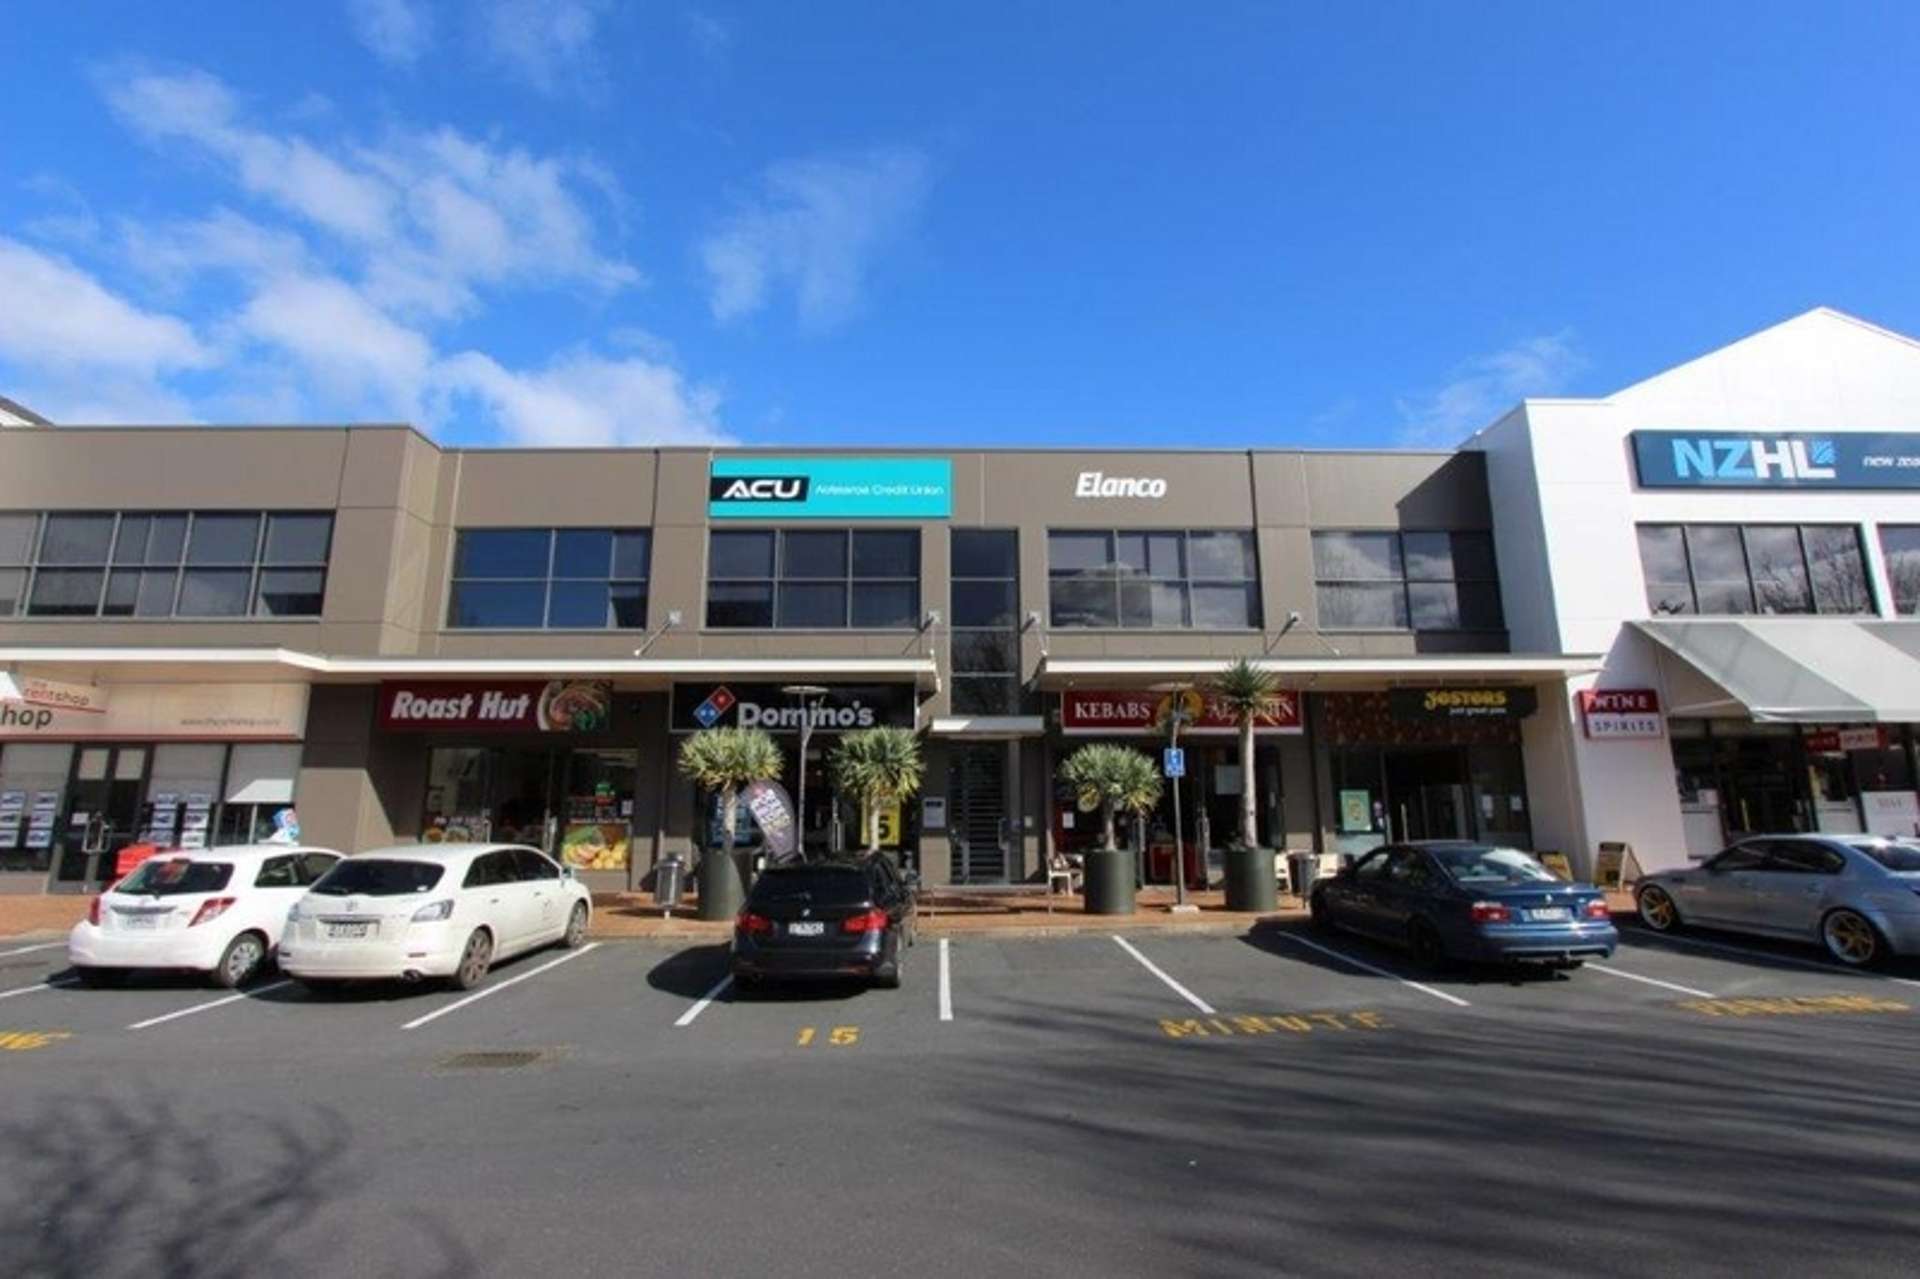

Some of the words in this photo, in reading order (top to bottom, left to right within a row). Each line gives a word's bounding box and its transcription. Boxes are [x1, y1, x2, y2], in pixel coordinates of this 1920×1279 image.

[1671, 439, 1836, 478] NZHL
[1863, 456, 1893, 467] new
[722, 479, 801, 499] ACU
[872, 484, 908, 496] Credit
[910, 485, 945, 496] Union
[1075, 471, 1168, 498] Elanco
[391, 691, 473, 720] Roast
[478, 692, 529, 720] Hut
[1074, 702, 1151, 720] KEBABS
[1594, 695, 1649, 709] WINE
[738, 702, 875, 727] Domino's
[796, 1026, 860, 1047] 15
